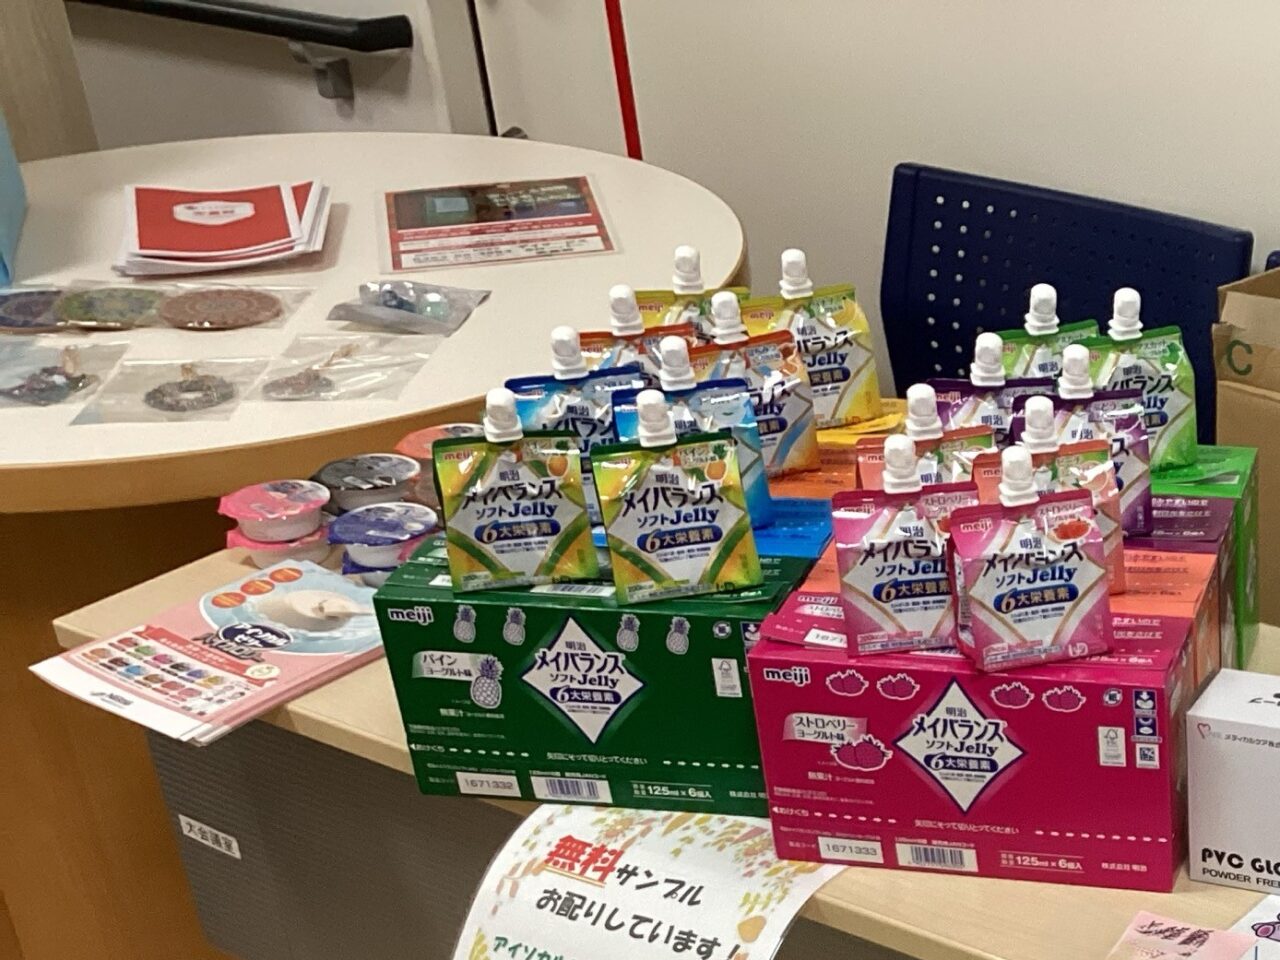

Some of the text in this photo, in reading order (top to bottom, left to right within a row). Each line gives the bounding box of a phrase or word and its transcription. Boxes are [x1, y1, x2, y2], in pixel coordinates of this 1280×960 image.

[1226, 339, 1253, 376] C
[981, 415, 1003, 426] 明治
[500, 470, 520, 481] 明治
[656, 473, 679, 485] 明治
[921, 472, 944, 484] 明治
[462, 478, 564, 508] メイバランス
[622, 482, 725, 517] メイバランス
[900, 526, 924, 538] 明治
[960, 519, 992, 533] meiji
[1020, 537, 1042, 550] 明治
[983, 543, 1086, 577] メイバランス
[388, 608, 433, 624] meiji
[565, 641, 586, 651] 明治
[422, 653, 458, 667] パイン
[535, 650, 628, 674] メイバランス
[424, 666, 472, 677] ヨーグルト味
[763, 667, 809, 686] meiji
[946, 707, 967, 717] 明治
[794, 716, 857, 731] ストロベリー
[912, 716, 1007, 742] メイバランス
[797, 728, 846, 744] ヨーグルト味
[925, 740, 999, 756] ソフトJelly
[929, 752, 993, 772] 6大栄養素
[464, 778, 513, 790] 1671332
[826, 844, 878, 856] 1671333
[1201, 848, 1244, 870] PVC
[544, 834, 706, 908] 無料サンプル
[1202, 867, 1252, 885] POWDER
